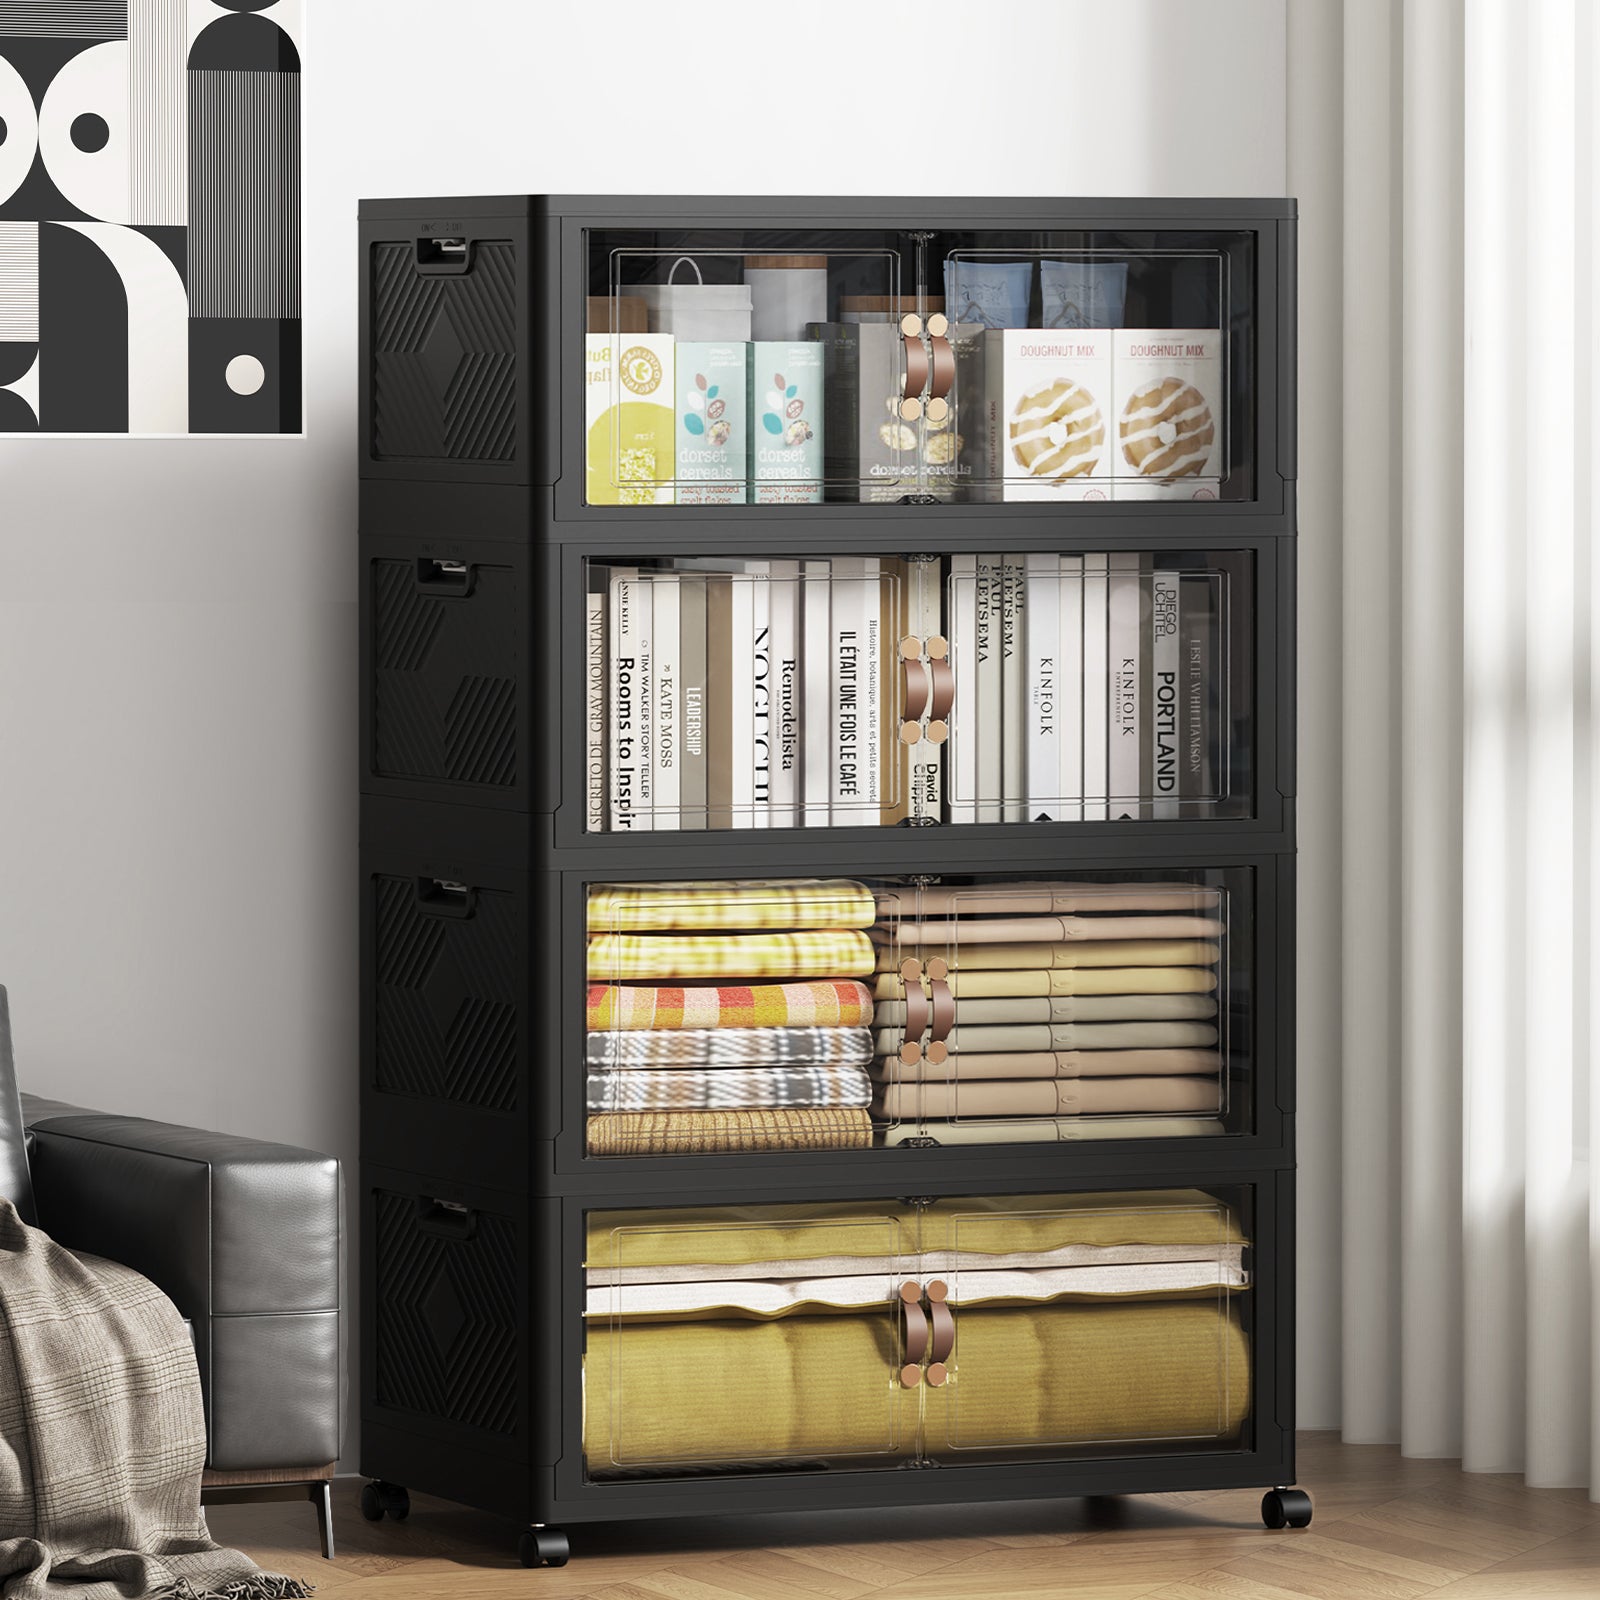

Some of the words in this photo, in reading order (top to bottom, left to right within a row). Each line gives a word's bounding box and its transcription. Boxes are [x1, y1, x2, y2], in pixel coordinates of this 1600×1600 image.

[1020, 345, 1074, 357] DOUGHNUT
[1076, 345, 1095, 357] MIX
[1130, 344, 1184, 357] DOUGHNUT
[1186, 344, 1204, 357] MIX
[680, 448, 728, 463] dorset
[680, 464, 733, 479] cereals
[758, 448, 806, 463] dorset
[758, 464, 811, 479] cereals
[991, 565, 1000, 616] PAUL
[1015, 565, 1024, 614] PAUL
[978, 565, 989, 663] SIETSEMA
[1004, 565, 1013, 658] SIETSEMA
[1155, 582, 1166, 643] UCHITEL
[1166, 590, 1177, 635] DIEGO
[590, 609, 602, 691] MOUNTAIN
[840, 631, 856, 642] IL
[869, 620, 877, 658] Histoire,
[641, 654, 650, 672] TIM
[840, 646, 860, 681] ÉTAIT
[1190, 640, 1201, 680] LESLIE
[619, 658, 634, 730] Rooms
[641, 676, 650, 720] WALKER
[660, 678, 672, 720] KATE
[840, 684, 856, 710] UNE
[868, 661, 877, 707] botanique,
[1040, 658, 1053, 736] KINFOLK
[1122, 659, 1135, 736] KINFOLK
[590, 695, 602, 732] GRAY
[686, 688, 702, 755] LEADERSHIP
[782, 658, 797, 771] Remodelista
[840, 714, 856, 742] FOIS
[869, 709, 877, 728] arts
[1157, 672, 1176, 792] PORTLAND
[590, 741, 602, 758] DE
[619, 737, 634, 760] to
[641, 724, 650, 759] STORY
[660, 724, 672, 768] MOSS
[840, 745, 856, 759] LE
[868, 742, 877, 768] petits
[590, 763, 602, 825] SECRETO
[641, 763, 650, 799] TELLER
[840, 763, 860, 796] CAFÉ
[926, 763, 938, 803] David
[614, 768, 636, 831] Inspir
